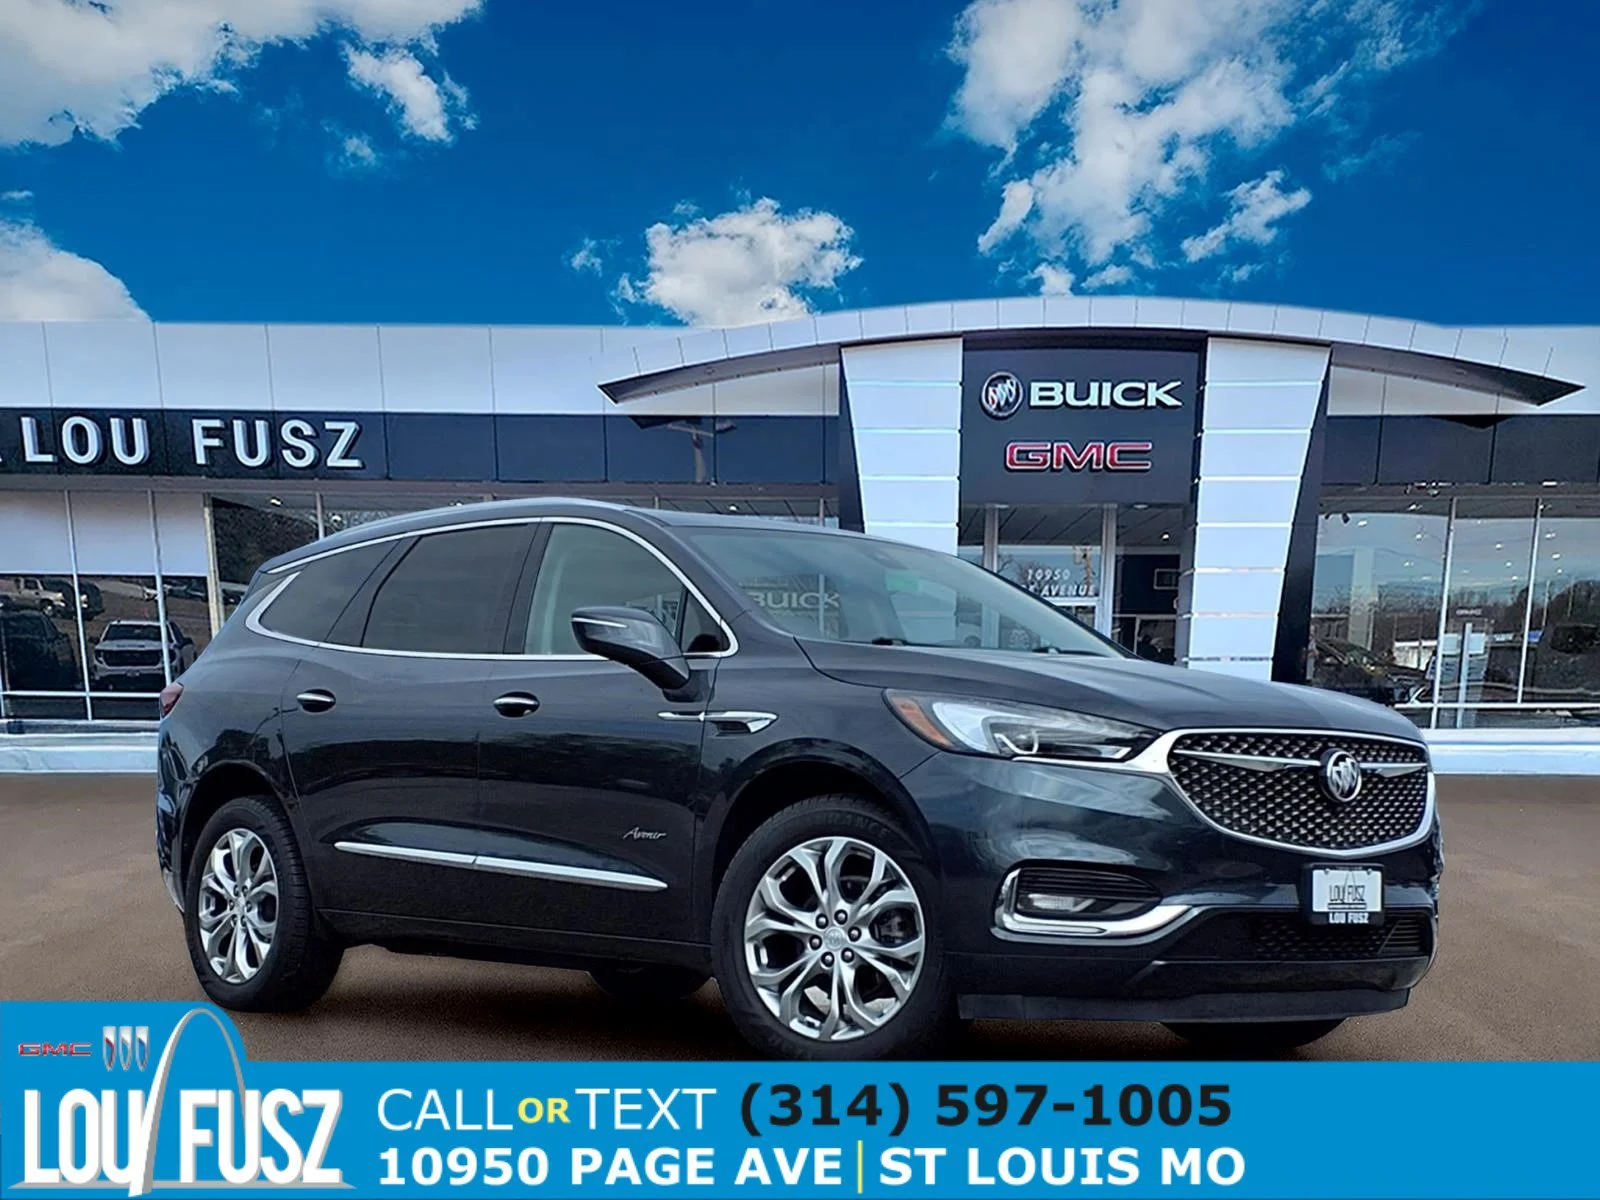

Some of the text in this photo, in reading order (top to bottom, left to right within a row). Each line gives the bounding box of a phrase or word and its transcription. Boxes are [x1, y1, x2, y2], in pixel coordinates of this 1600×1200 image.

[1030, 380, 1182, 408] BUICK
[20, 416, 364, 470] LOU FUSZ
[1006, 441, 1152, 471] GMC
[1027, 568, 1071, 581] 10950
[1041, 584, 1096, 597] AVENUE
[1328, 912, 1369, 924] LOU FUSZ
